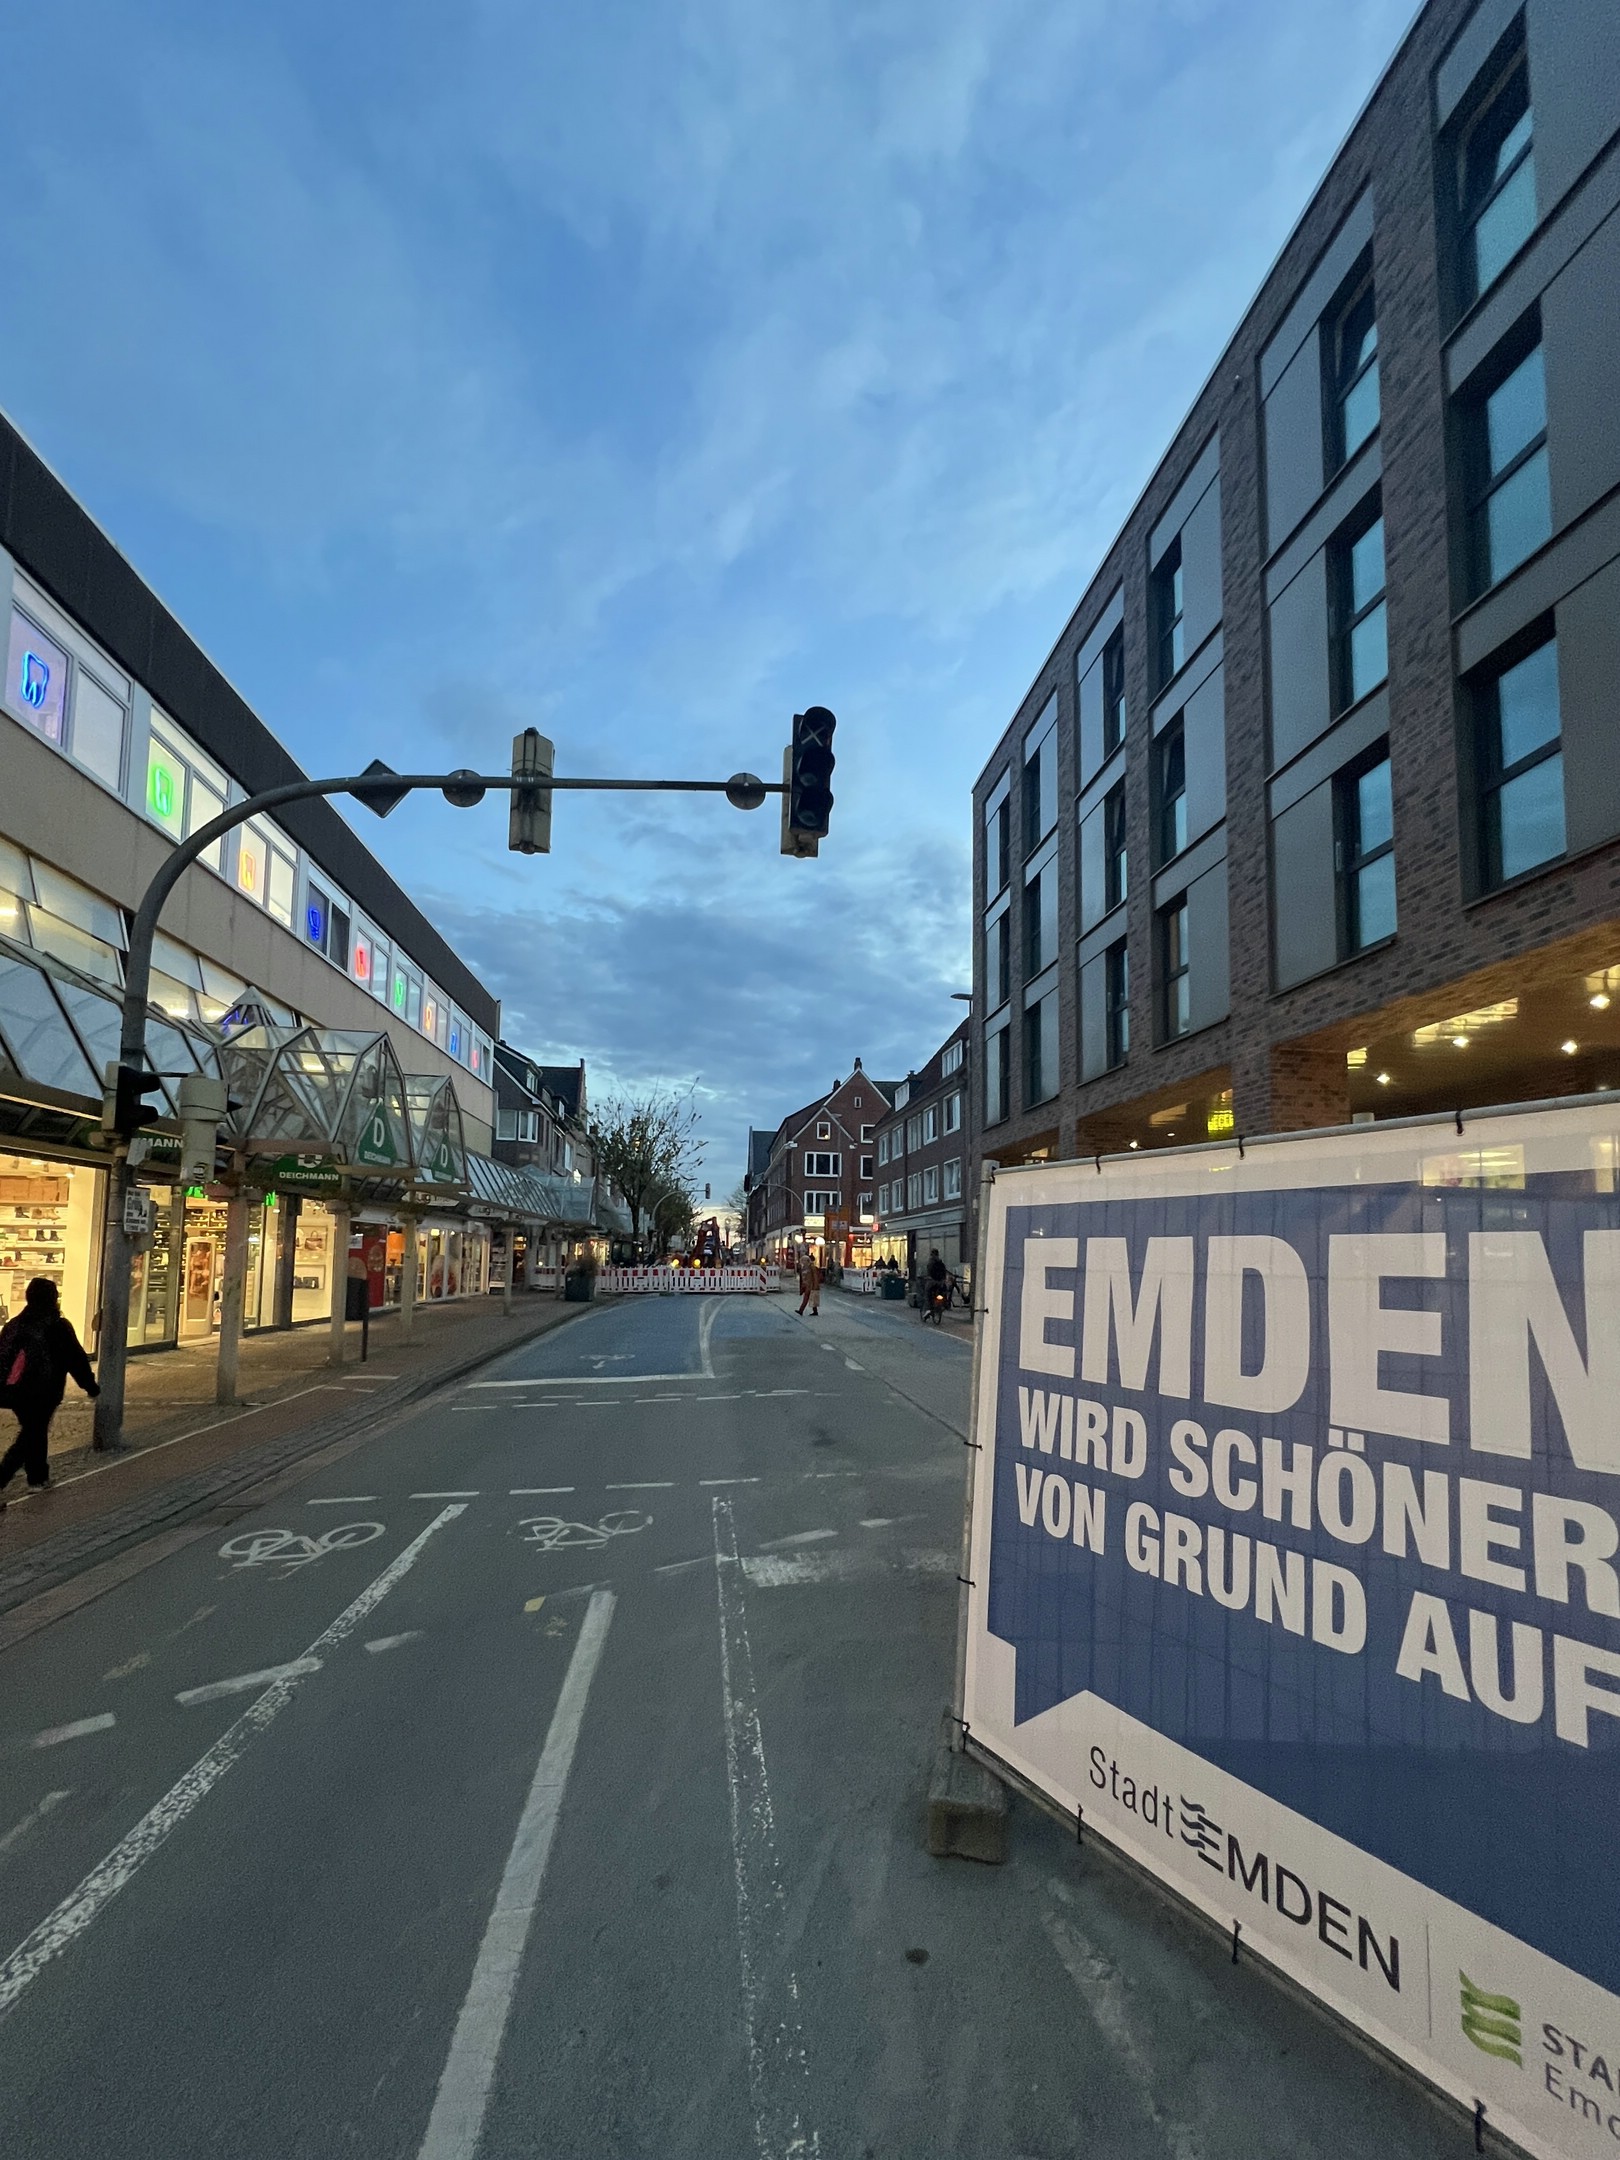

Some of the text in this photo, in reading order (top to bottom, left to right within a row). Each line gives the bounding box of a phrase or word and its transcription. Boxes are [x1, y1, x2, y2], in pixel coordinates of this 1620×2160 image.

[279, 1171, 339, 1181] DEICHMANN
[373, 1117, 385, 1148] D
[440, 1144, 448, 1168] D
[1018, 1230, 1620, 1475] EMDEN
[1017, 1385, 1620, 1619] WIRD SCHÖNER
[1015, 1462, 1620, 1749] VON GRUND AUF
[1089, 1745, 1400, 1993] Stadt EMDEN
[1542, 2023, 1620, 2097] STA
